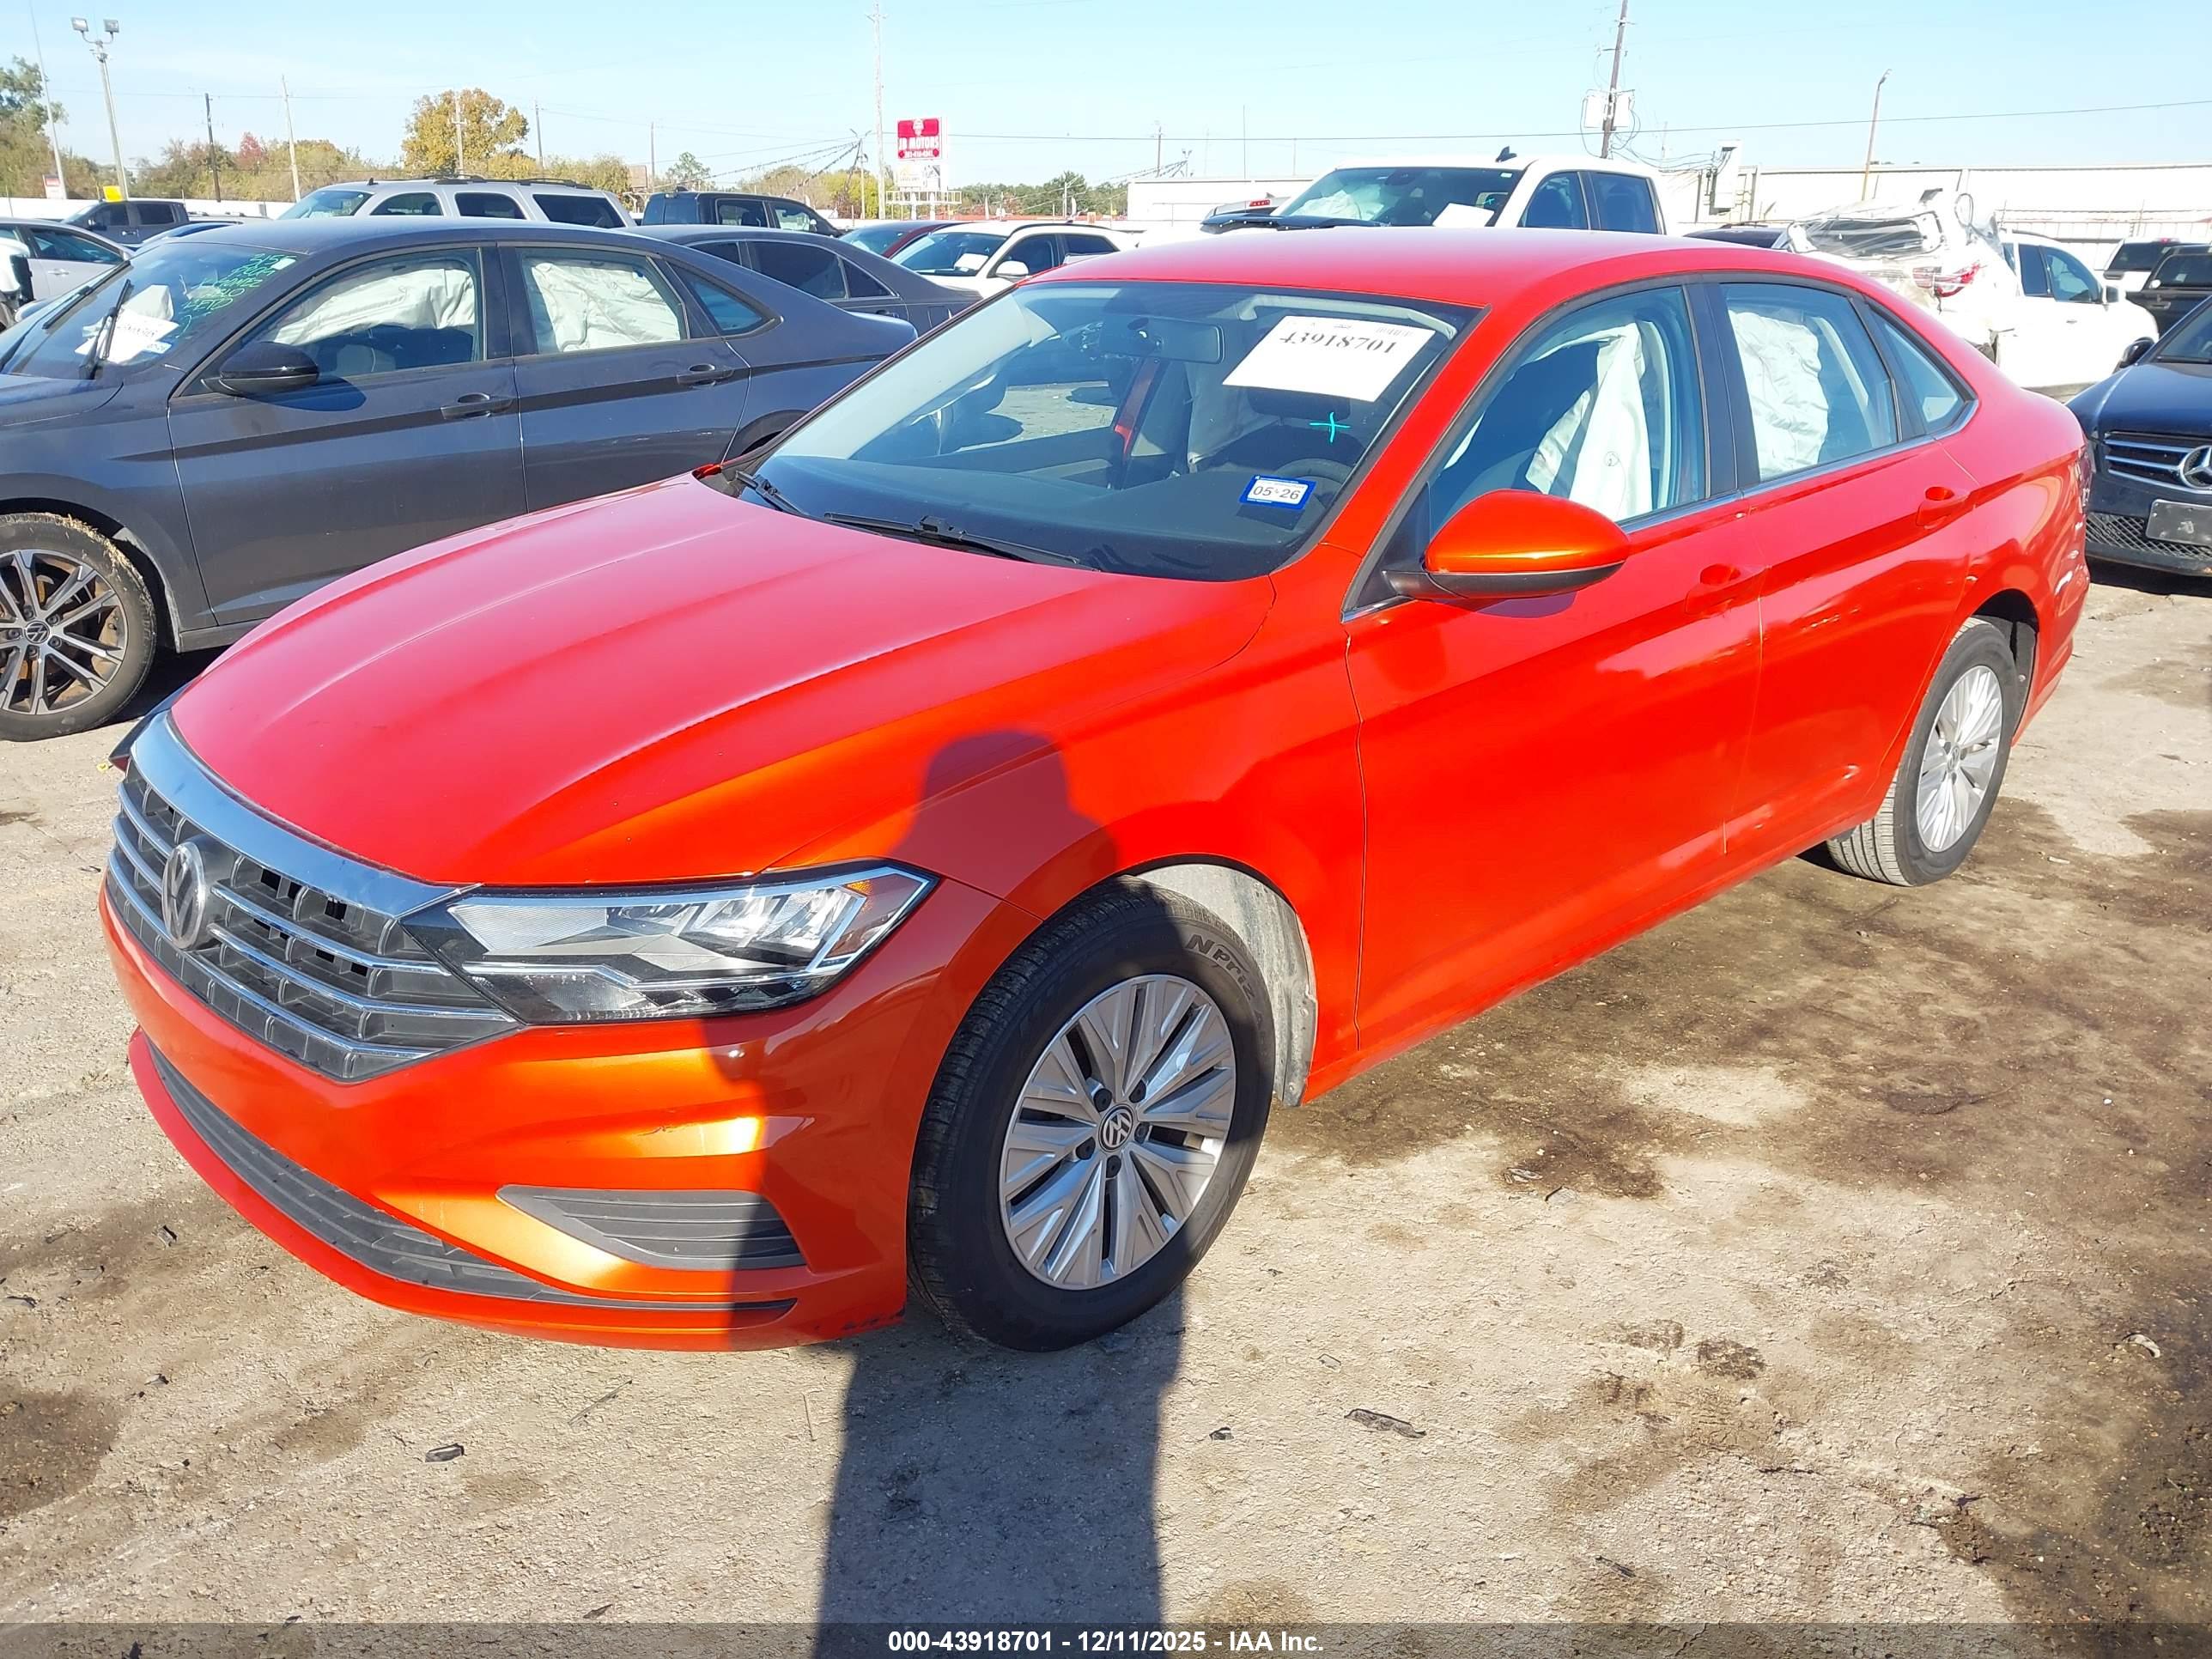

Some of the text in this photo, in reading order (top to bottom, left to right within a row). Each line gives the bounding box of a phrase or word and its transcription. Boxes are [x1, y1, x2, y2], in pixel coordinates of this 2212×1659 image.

[908, 135, 940, 149] MOTORS
[1279, 330, 1398, 354] 43918701
[1252, 485, 1274, 496] 05
[1279, 488, 1301, 500] 26
